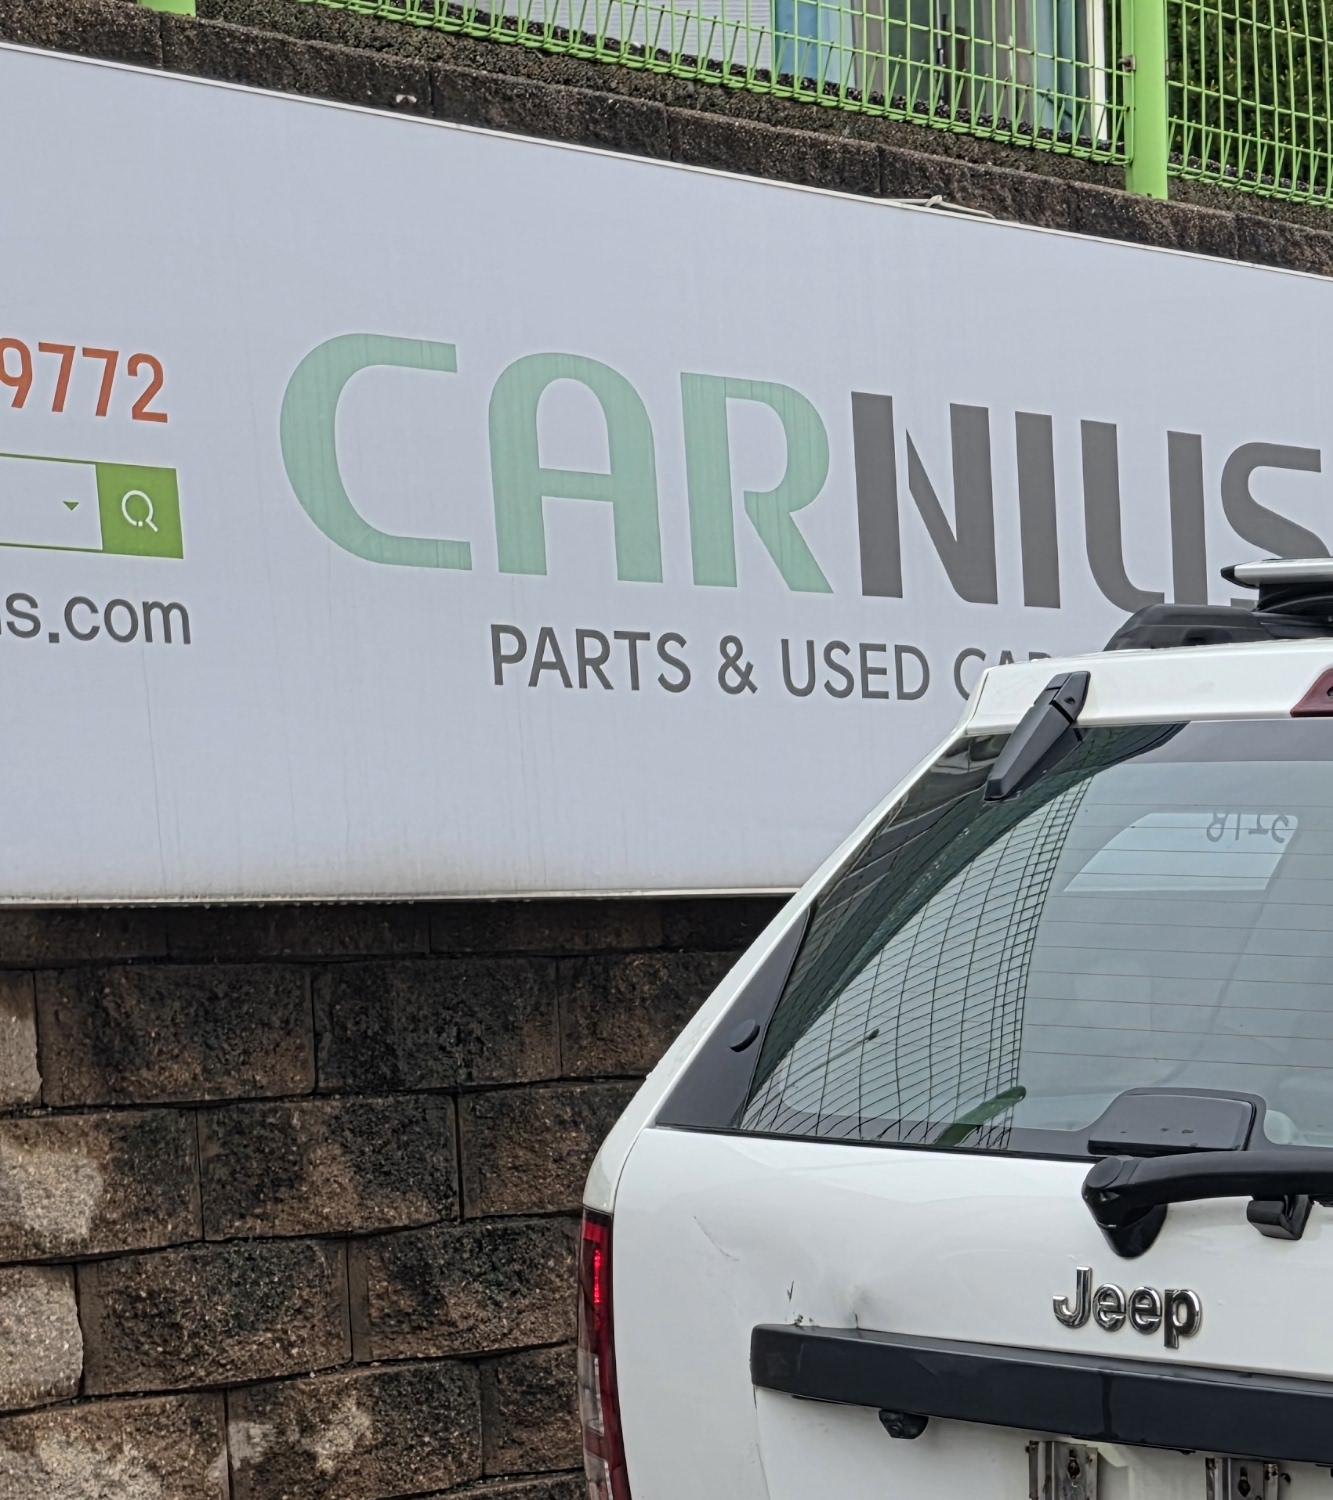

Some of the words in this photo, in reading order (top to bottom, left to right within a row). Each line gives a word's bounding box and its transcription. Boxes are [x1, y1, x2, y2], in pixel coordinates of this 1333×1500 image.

[0, 337, 169, 423] 9772
[279, 332, 1332, 613] CARNIUS
[0, 592, 192, 645] s.com
[490, 623, 692, 694] PARTS
[717, 634, 758, 695] &
[780, 638, 930, 700] USED
[1052, 1266, 1203, 1349] Jeep
